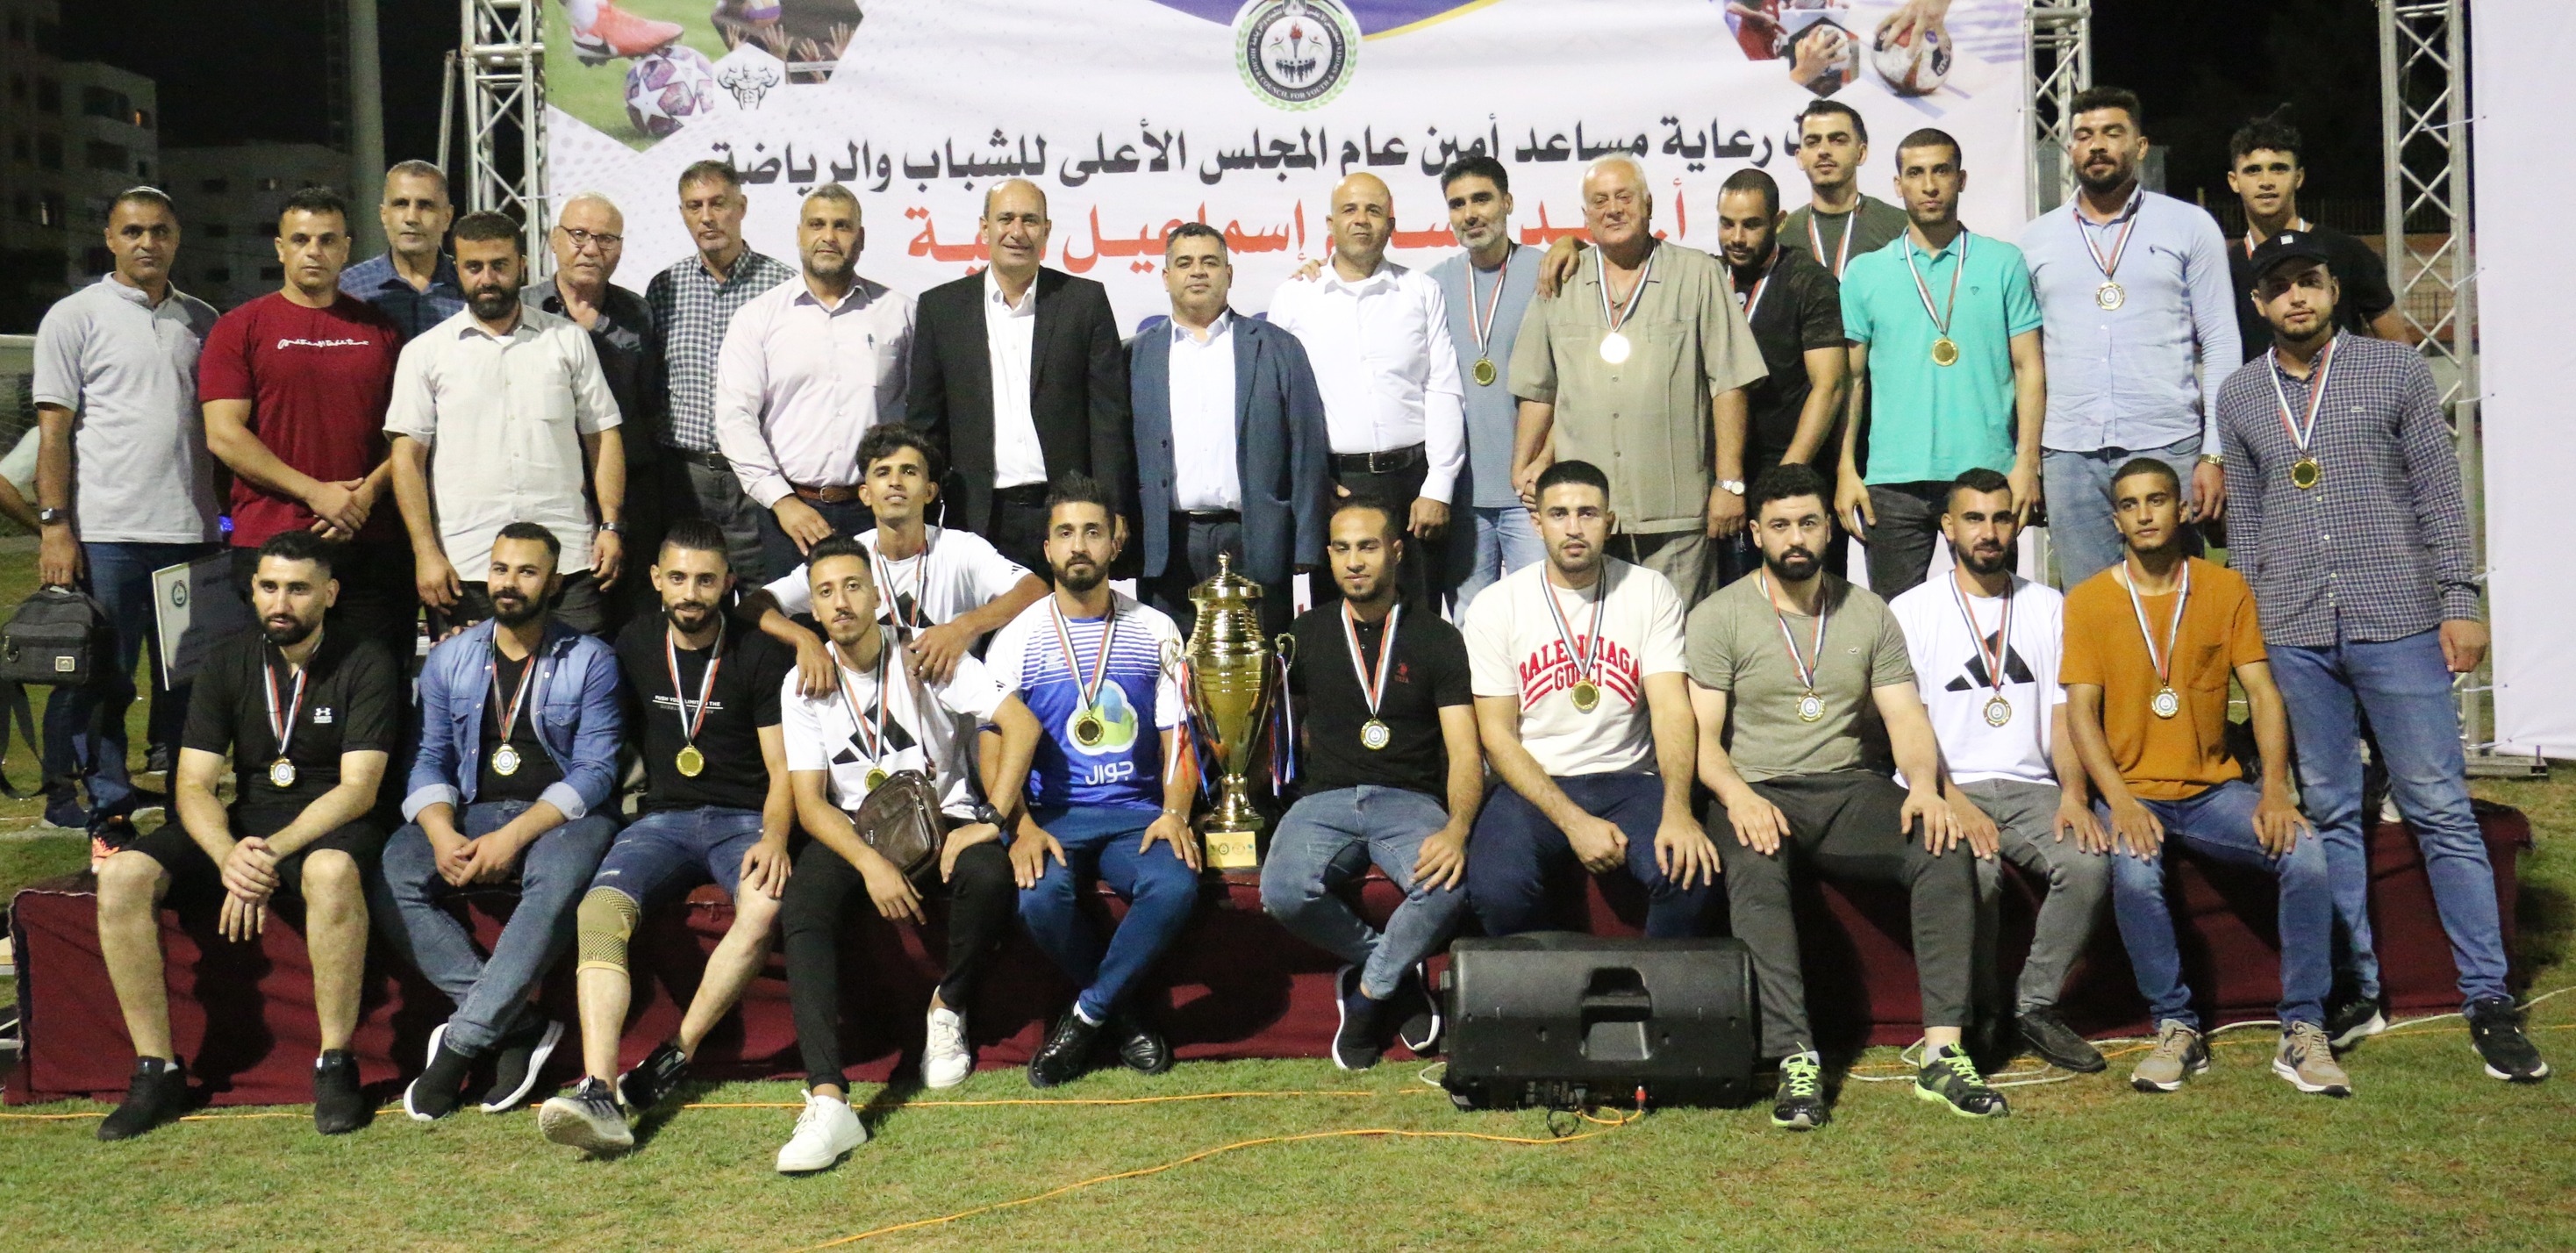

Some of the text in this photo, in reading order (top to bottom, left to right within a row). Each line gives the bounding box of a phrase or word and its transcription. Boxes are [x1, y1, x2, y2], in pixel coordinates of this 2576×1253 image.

[1259, 76, 1289, 97] COUNCIL
[1306, 79, 1330, 97] YOUTH
[1331, 45, 1343, 74] SPORTS
[712, 139, 892, 197] والرياضة
[903, 128, 1047, 192] للشباب
[1059, 118, 1186, 188] الأعلى
[1199, 125, 1327, 185] المجلس
[1340, 124, 1409, 176] عام
[1420, 113, 1499, 175] أمين
[1514, 118, 1649, 163] مساعد
[1660, 115, 1772, 173] رعاية
[1519, 634, 1639, 691] BALENIAGA
[1084, 760, 1134, 785] جوال
